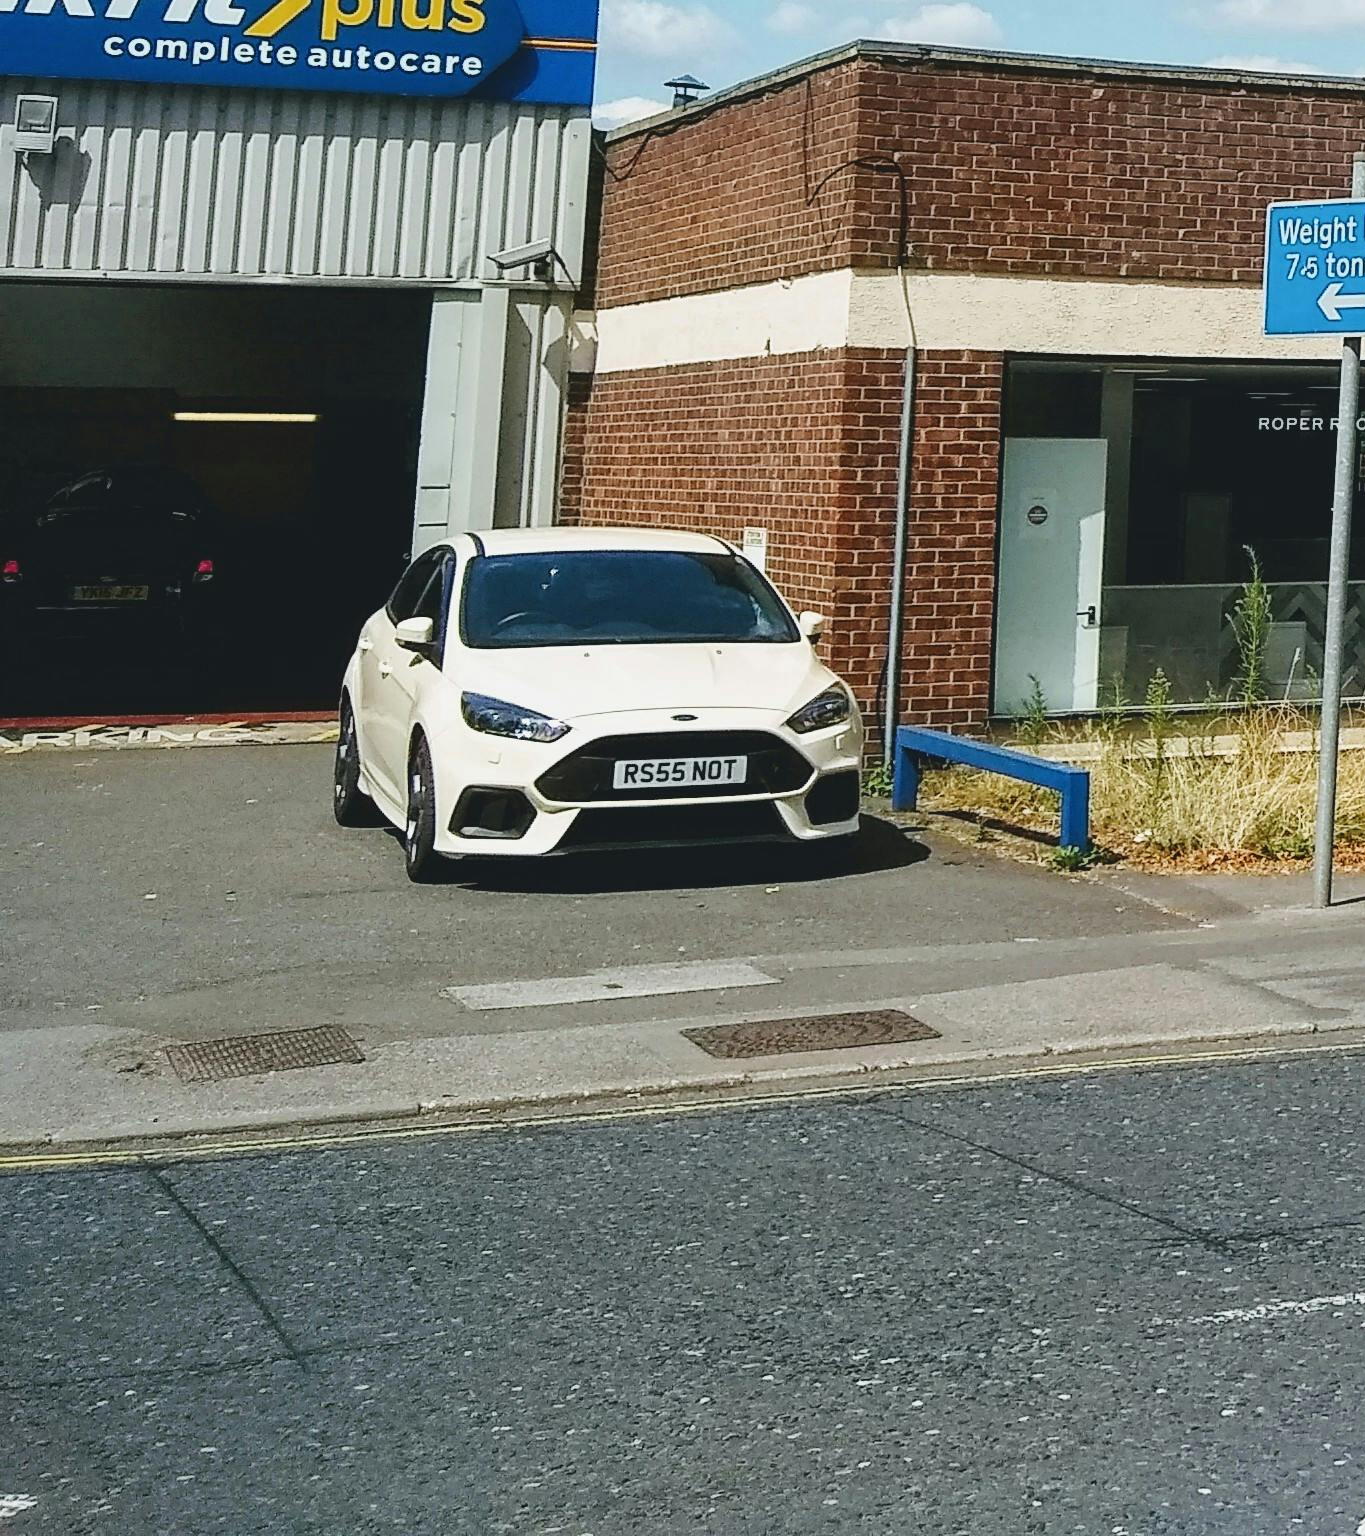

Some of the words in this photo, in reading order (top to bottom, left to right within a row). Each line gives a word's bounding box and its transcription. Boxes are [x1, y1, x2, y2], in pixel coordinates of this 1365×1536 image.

[104, 36, 297, 65] complete
[307, 46, 482, 75] autocare
[1279, 216, 1357, 249] Weight
[1258, 417, 1323, 431] ROPER
[624, 762, 686, 783] RS55
[692, 759, 737, 781] NOT
